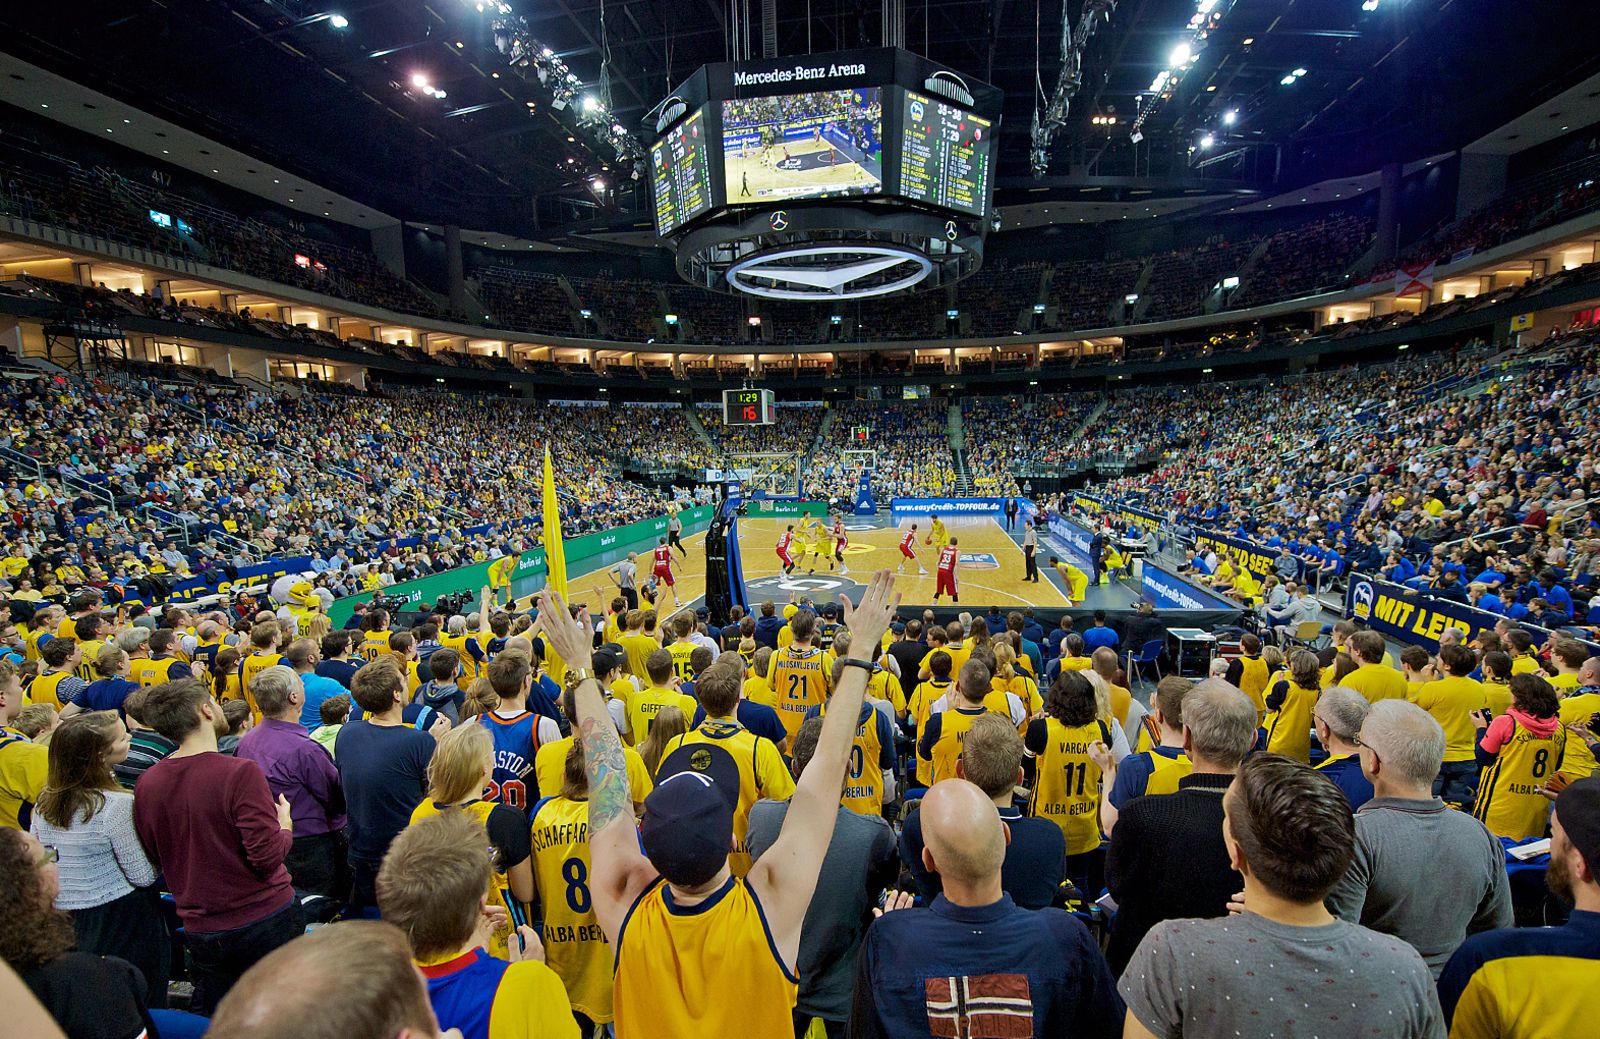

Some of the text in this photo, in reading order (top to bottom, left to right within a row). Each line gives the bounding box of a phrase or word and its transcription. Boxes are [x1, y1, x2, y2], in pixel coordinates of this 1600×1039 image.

[734, 63, 866, 86] Mercedes-Benz Arena
[942, 127, 960, 142] 1:29
[151, 170, 171, 187] 417
[288, 219, 305, 233] 416
[739, 393, 758, 403] 1:29
[743, 405, 757, 421] 16
[895, 502, 1000, 513] www.easyCredit-TOPFOUR.de
[519, 557, 535, 571] Berlin
[412, 589, 422, 600] ist
[1374, 594, 1414, 629] MIT
[788, 674, 808, 700] 21
[1533, 748, 1549, 778] 8
[1064, 762, 1087, 797] 11
[482, 779, 526, 811] 20
[846, 785, 874, 798] BERLIN
[1509, 783, 1532, 795] ALBA
[1044, 801, 1095, 815] ALBA BERLIN
[562, 857, 592, 914] 8
[545, 924, 576, 943] ALBA
